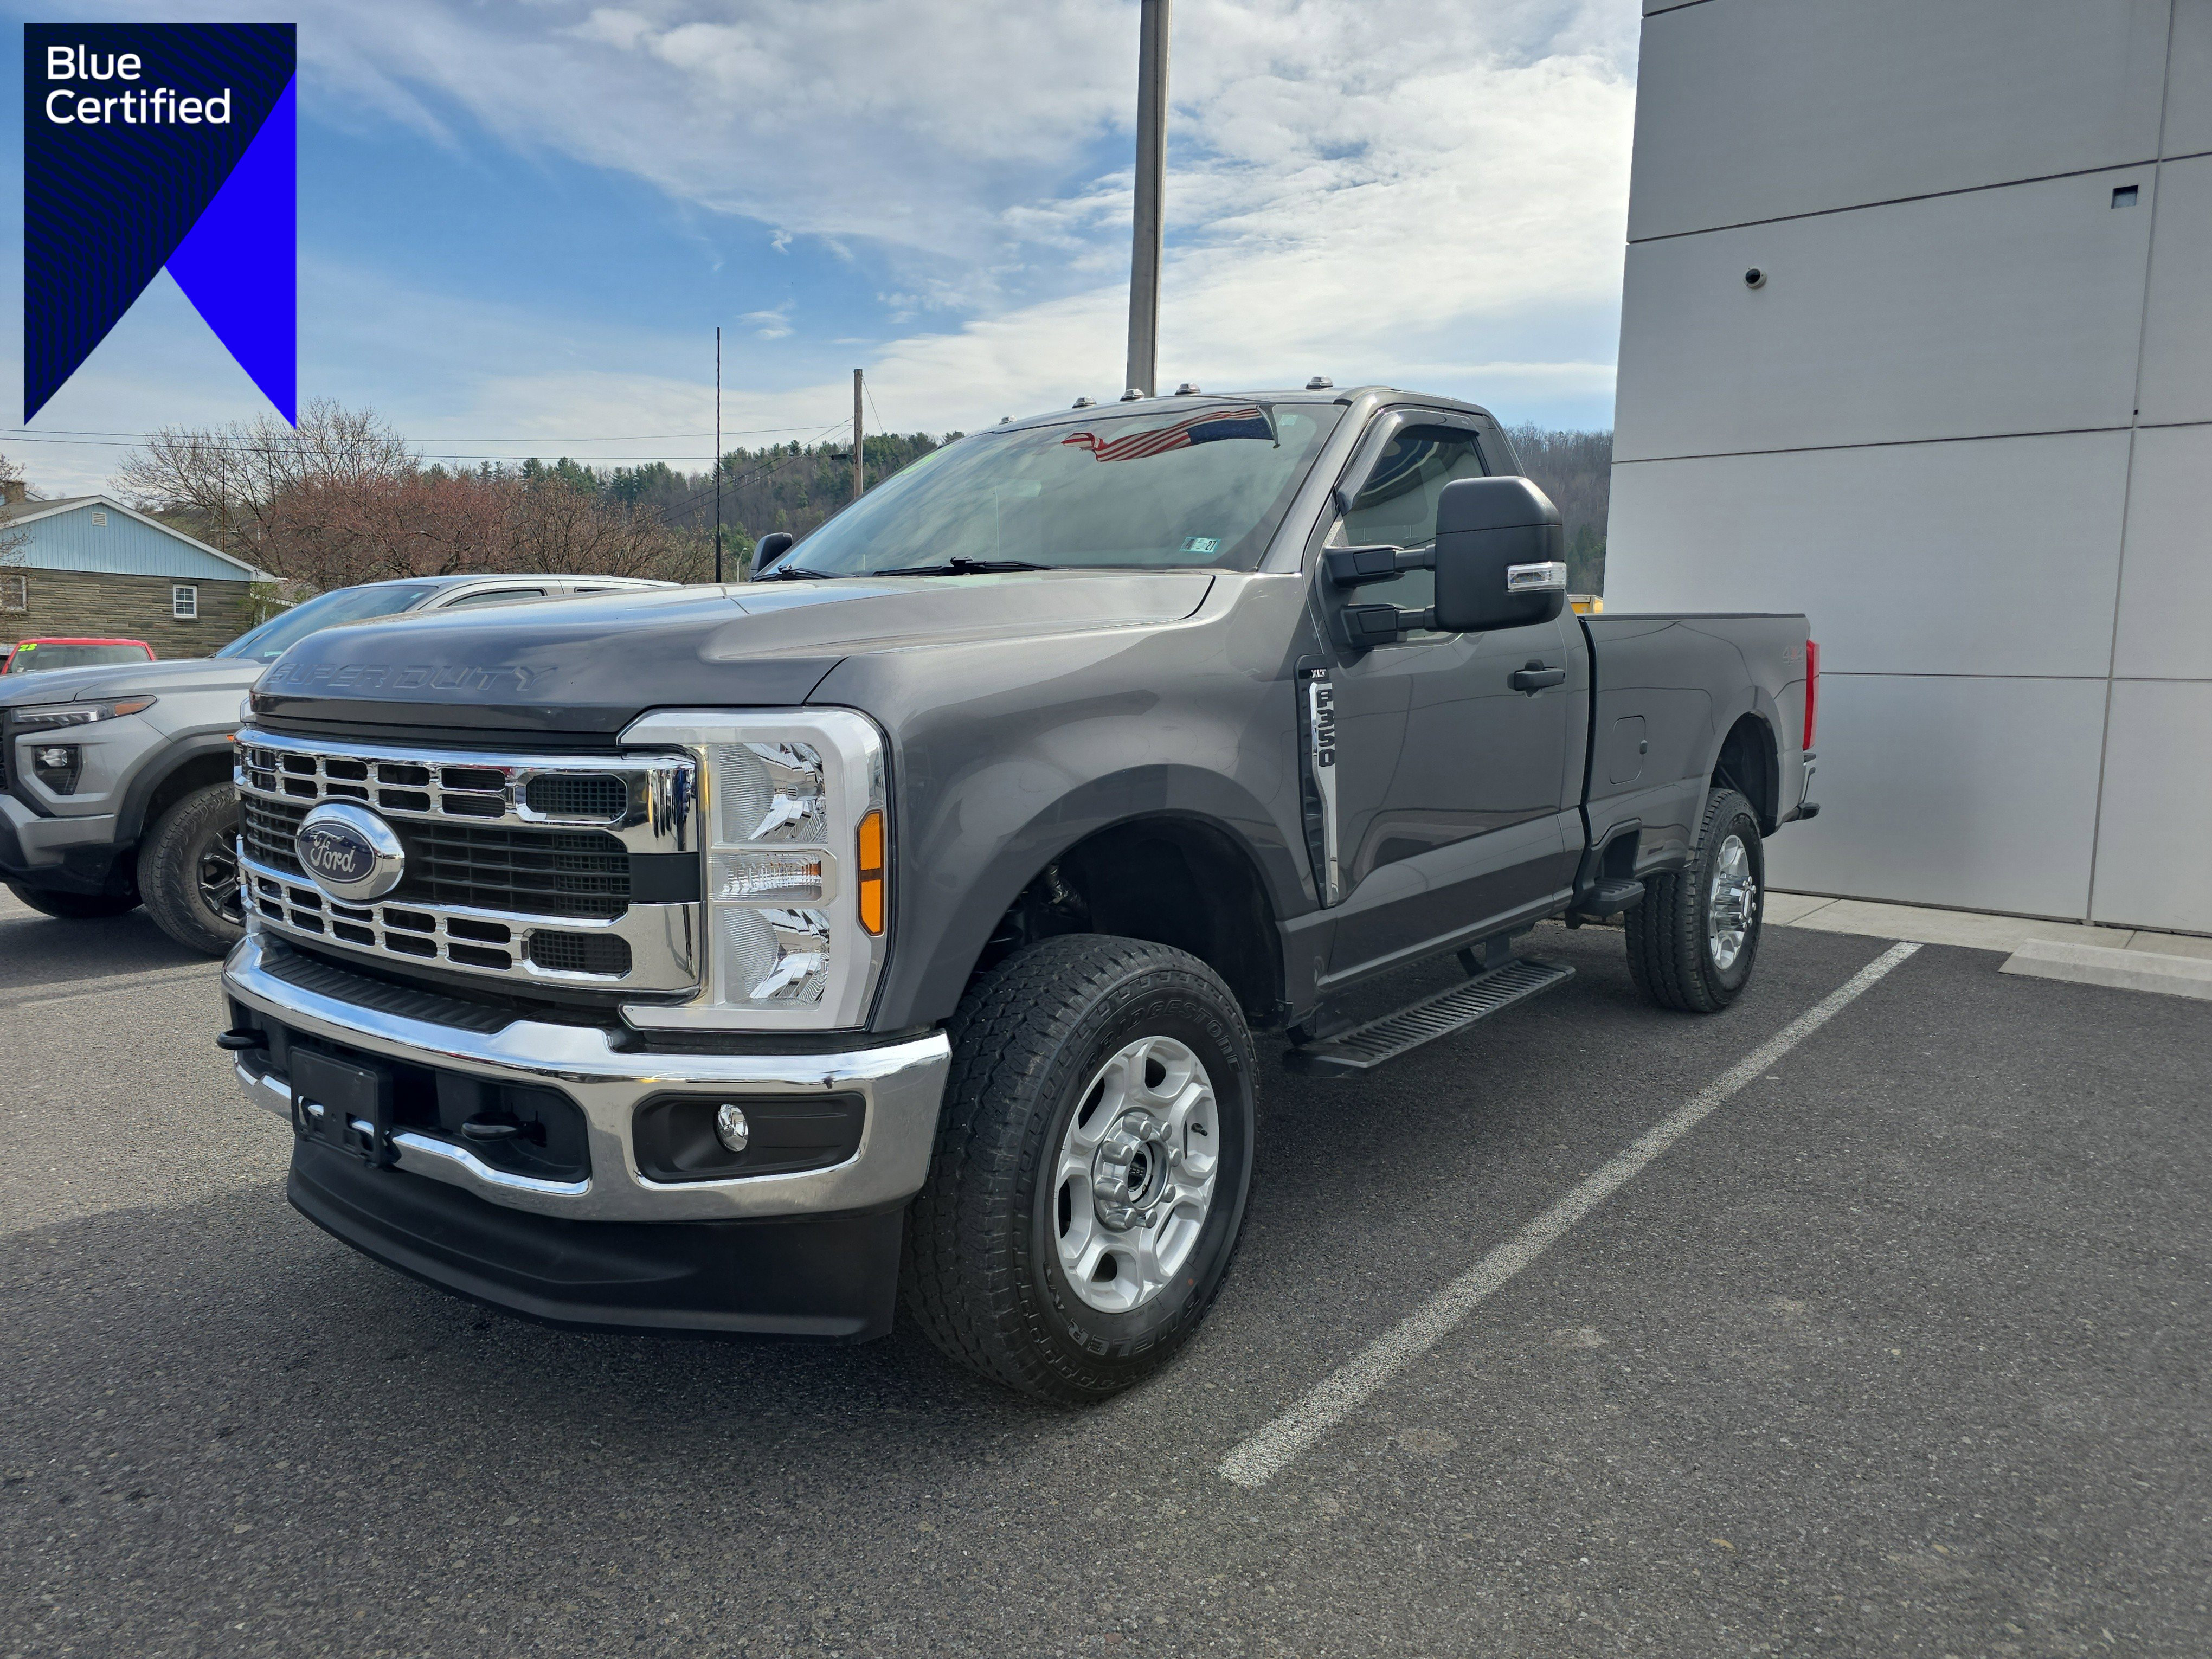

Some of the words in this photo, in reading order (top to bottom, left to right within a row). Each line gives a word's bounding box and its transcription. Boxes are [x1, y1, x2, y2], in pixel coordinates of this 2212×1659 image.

[1205, 540, 1217, 551] 27
[267, 663, 393, 687] SUPER
[393, 665, 558, 691] DUTY
[1311, 668, 1327, 678] XLT
[308, 831, 356, 873] Ford
[1079, 1000, 1242, 1084] BRIDGESTONE
[1067, 1280, 1201, 1357] DUELER
